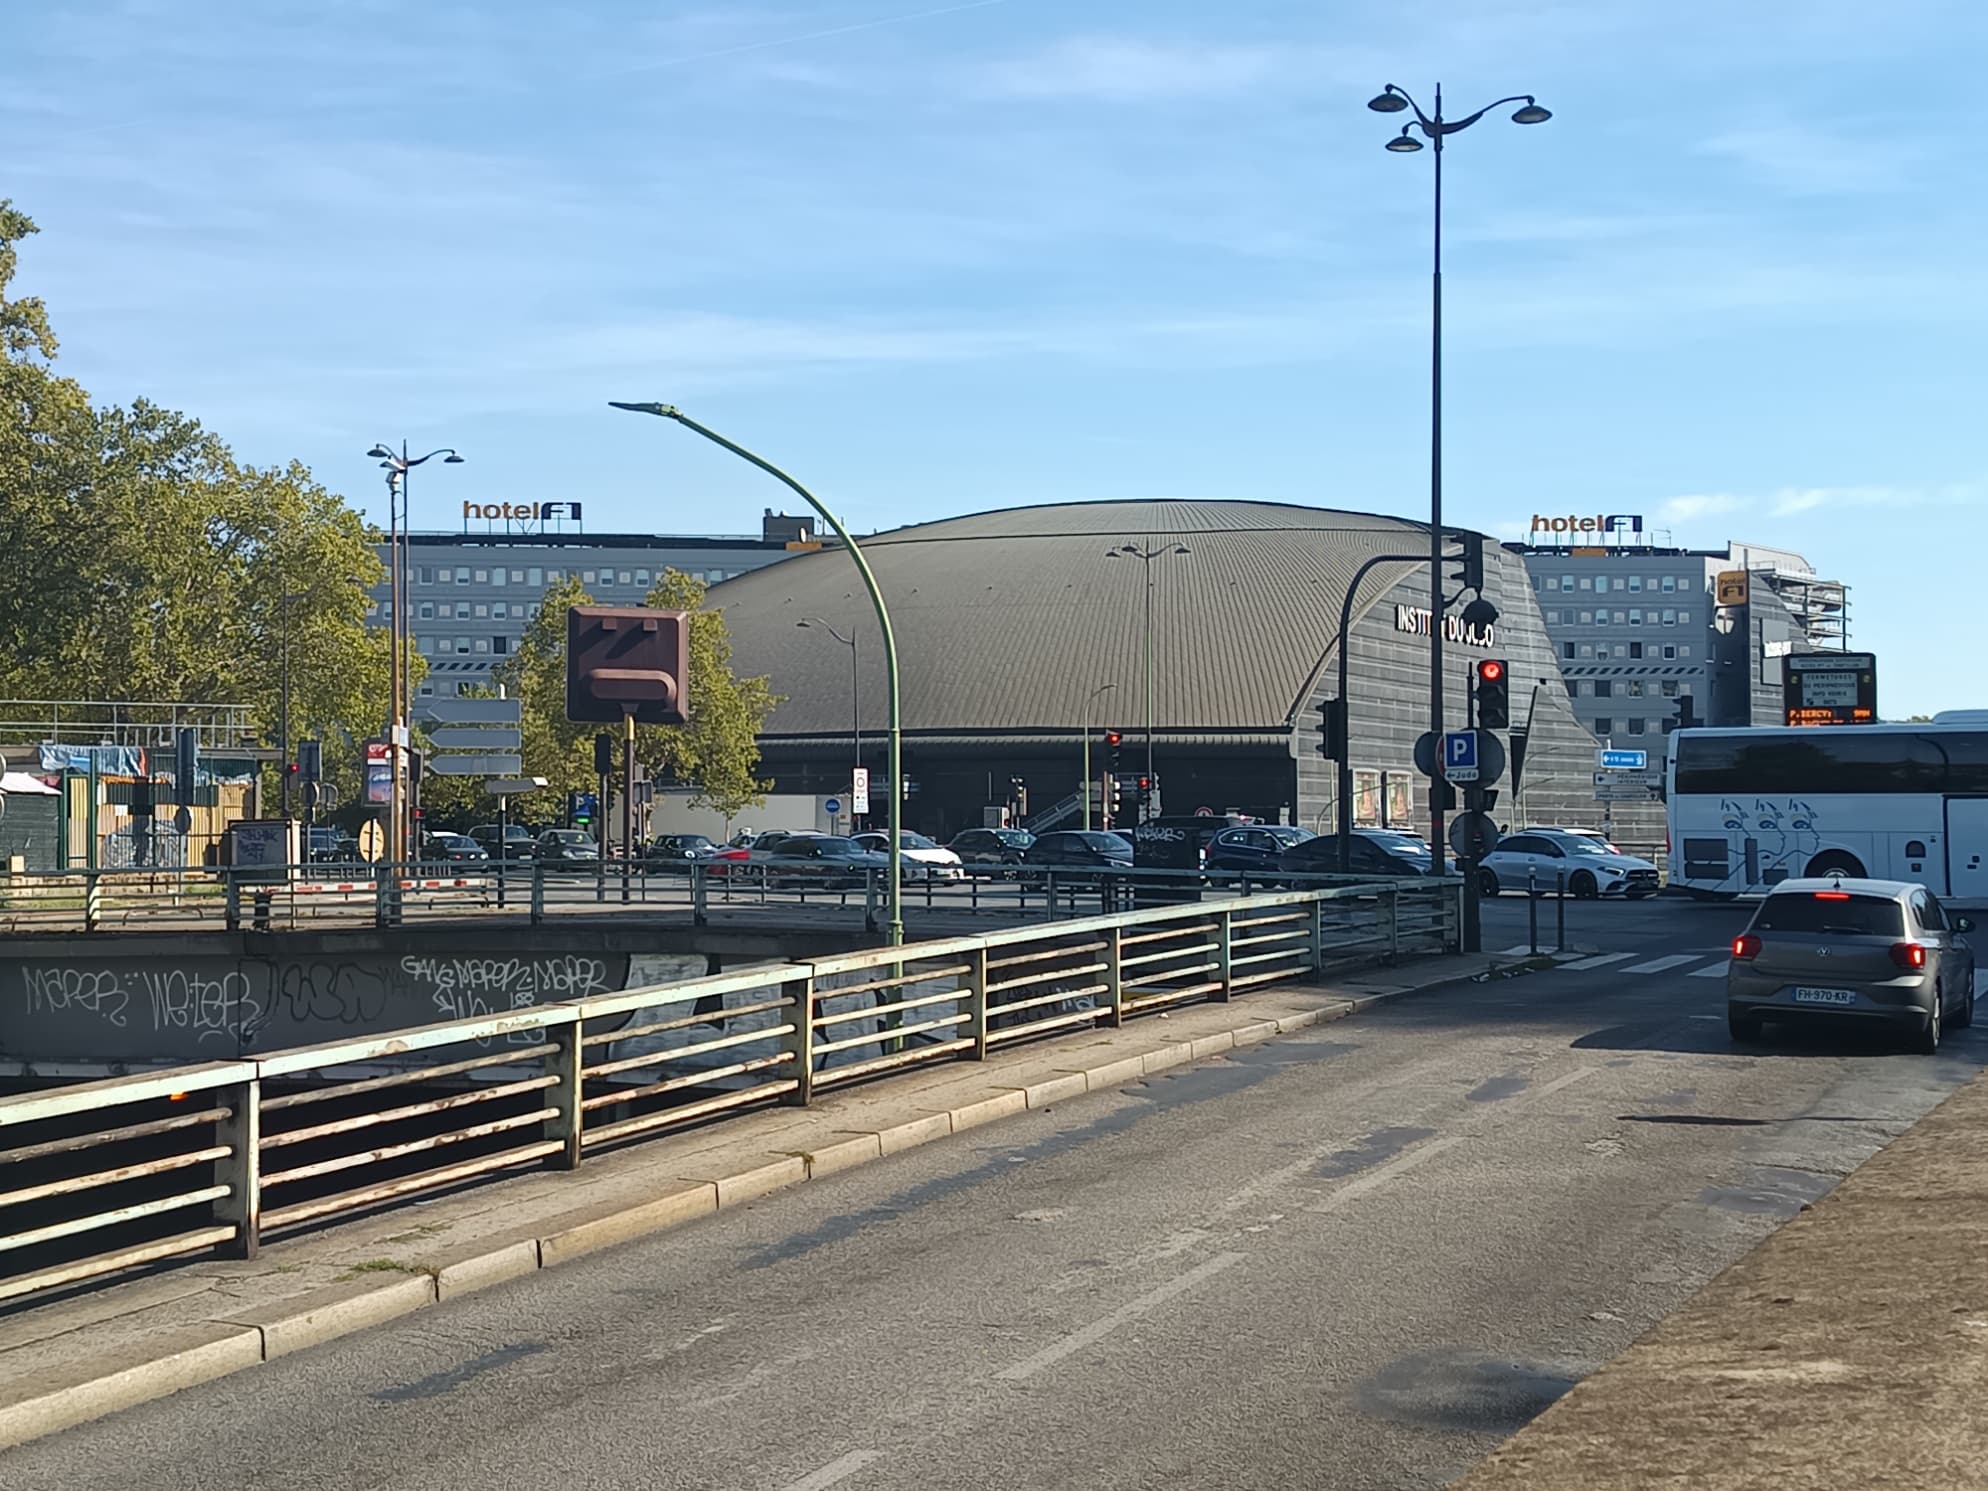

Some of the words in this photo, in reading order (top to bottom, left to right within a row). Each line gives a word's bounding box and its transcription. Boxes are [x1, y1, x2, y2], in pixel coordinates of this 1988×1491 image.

[1449, 615, 1464, 642] DU
[1454, 739, 1468, 761] P
[1797, 989, 1848, 1002] FH-970-KR
